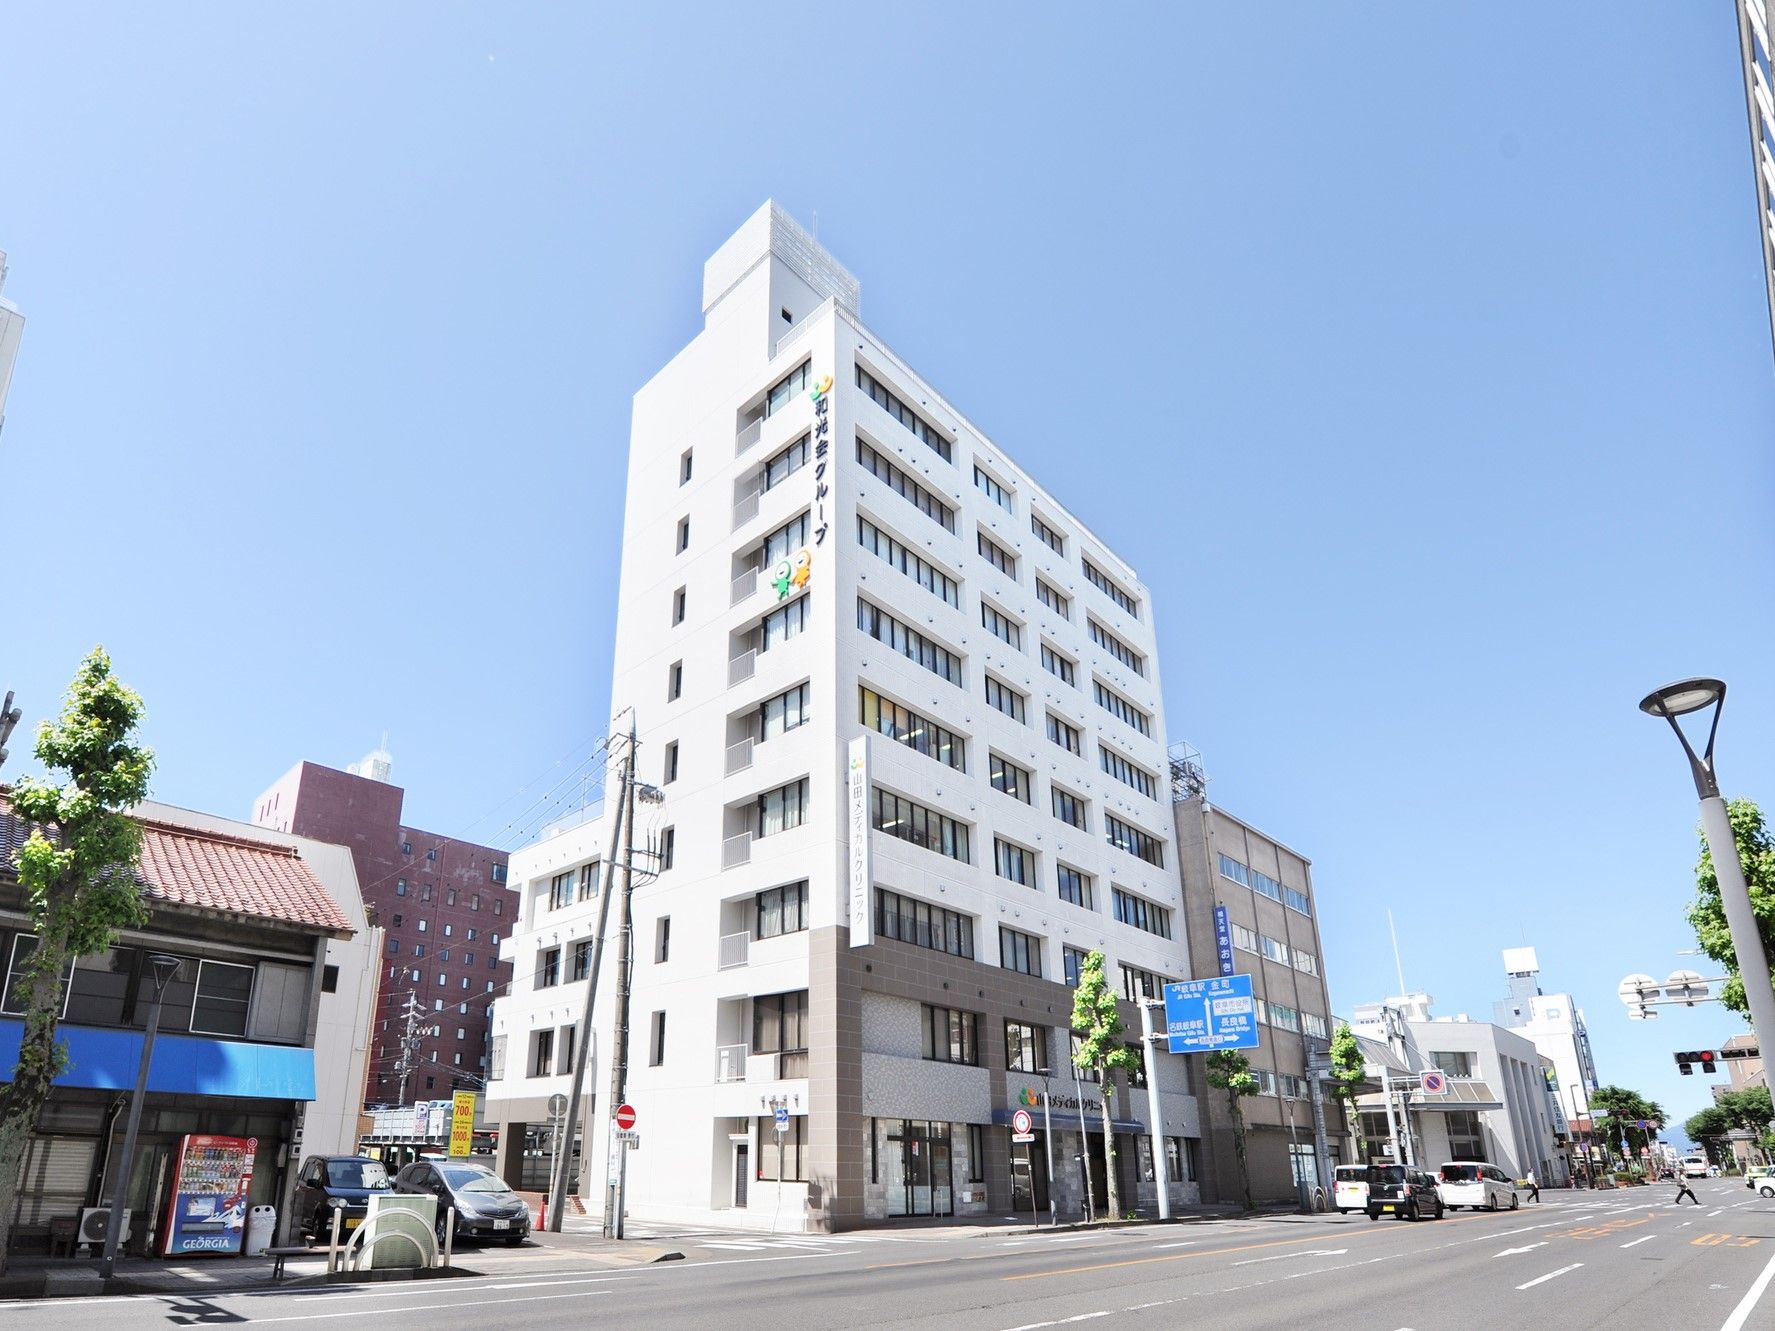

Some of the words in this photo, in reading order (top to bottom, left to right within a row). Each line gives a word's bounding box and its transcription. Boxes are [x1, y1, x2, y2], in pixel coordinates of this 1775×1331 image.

[815, 396, 829, 546] 和光会グループ
[853, 772, 864, 924] 山田メディカルクリニック
[1219, 936, 1232, 973] あおき
[1221, 1015, 1248, 1027] 長良橋
[1551, 1093, 1565, 1131] 三井住友銀行
[182, 1237, 230, 1249] GEORGIA
